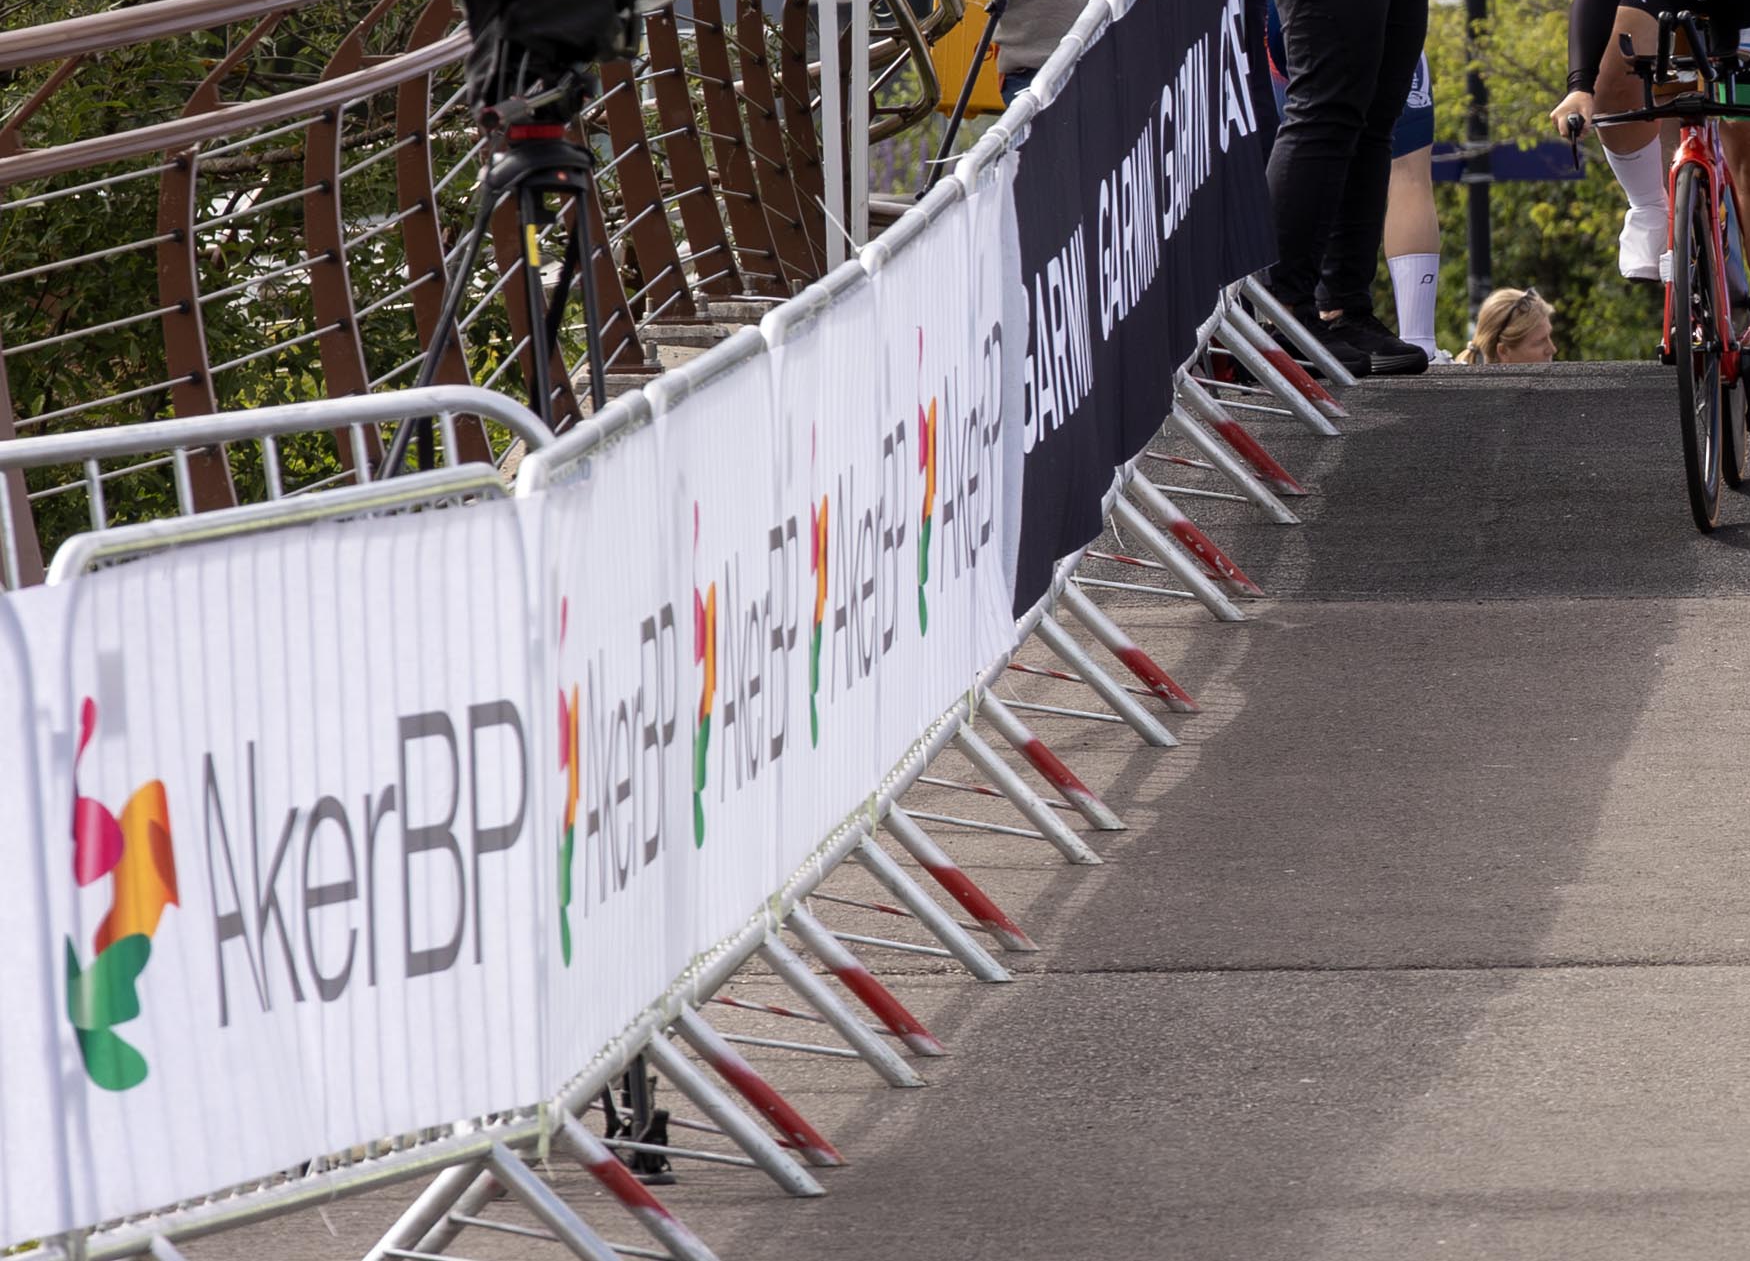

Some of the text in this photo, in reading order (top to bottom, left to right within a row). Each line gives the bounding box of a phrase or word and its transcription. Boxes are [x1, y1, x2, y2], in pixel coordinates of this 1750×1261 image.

[1098, 117, 1160, 340] GARMIN
[721, 514, 798, 803] AkerBP
[831, 419, 906, 703] AkerBP
[201, 698, 528, 1028] AkerBP
[584, 601, 676, 918] AkerBP
